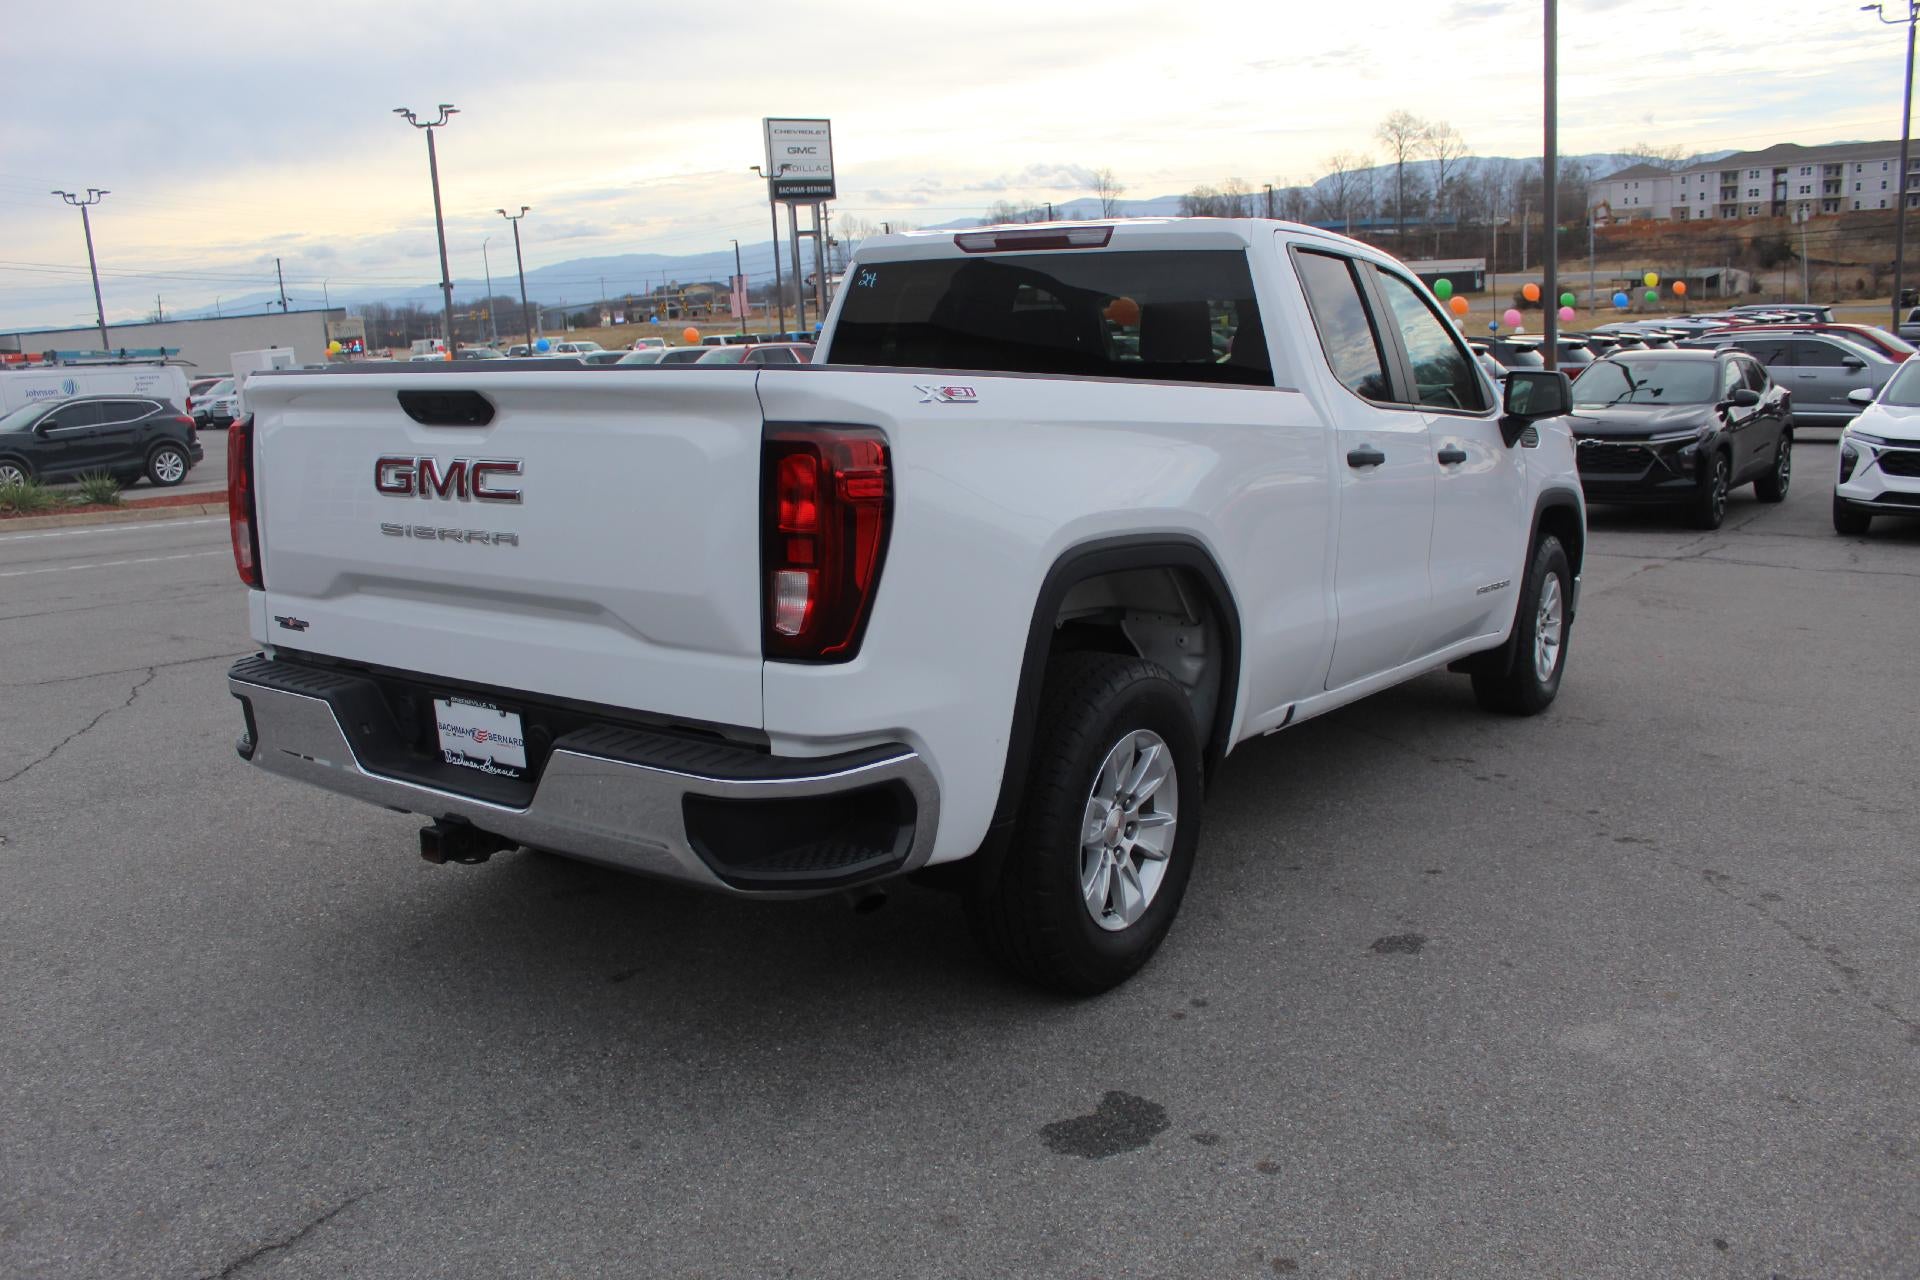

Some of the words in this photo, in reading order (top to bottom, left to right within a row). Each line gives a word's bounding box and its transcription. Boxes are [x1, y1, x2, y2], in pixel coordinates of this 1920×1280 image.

[787, 146, 817, 155] GMC
[25, 389, 58, 398] Johnson
[375, 455, 523, 504] GMC
[380, 522, 519, 547] SIERRA
[438, 722, 472, 736] BACHMAN
[487, 732, 524, 746] BERNARD
